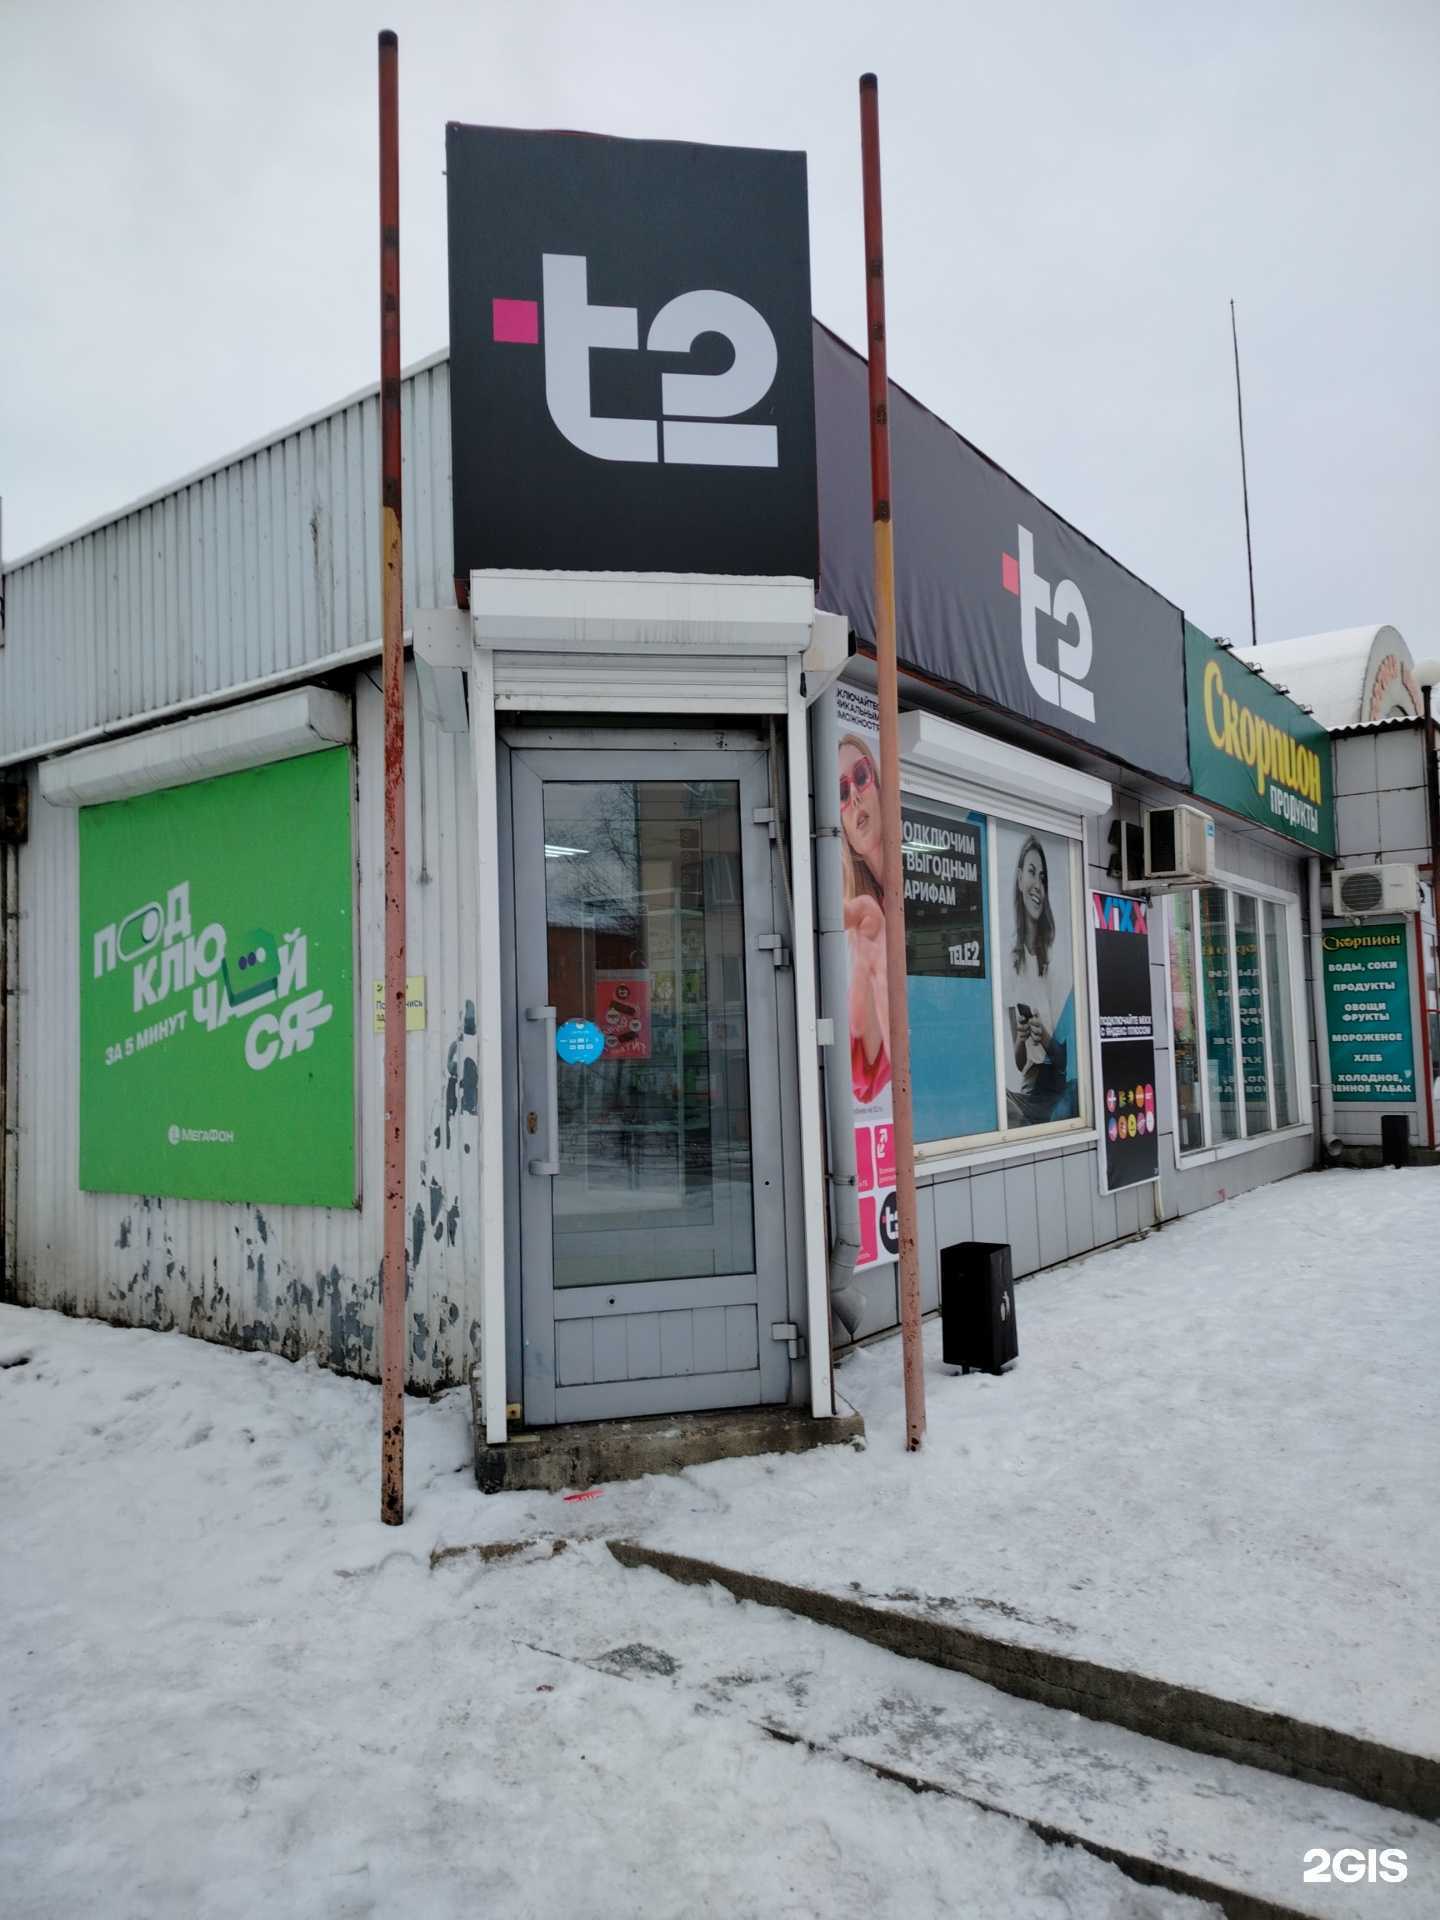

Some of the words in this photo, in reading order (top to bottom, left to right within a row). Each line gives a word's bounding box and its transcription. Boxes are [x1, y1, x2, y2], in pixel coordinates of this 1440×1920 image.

[542, 253, 779, 468] t2
[1017, 523, 1096, 724] t2
[1204, 660, 1321, 806] Скорпион
[901, 819, 976, 856] ОДКЛЮЧИМ
[905, 850, 978, 882] ВЫГОДНЫМ
[903, 878, 956, 906] АРИФАМ
[94, 880, 191, 979] ПОД
[949, 941, 981, 967] TELE2
[1323, 935, 1401, 951] Скорпион
[133, 922, 226, 1013] КЛЮ
[1367, 961, 1398, 971] СОКИ
[1333, 981, 1396, 993] ПРОДУКТЫ
[1342, 1012, 1390, 1023] ФРУКТЫ
[1344, 1003, 1387, 1012] ОВОЩИ
[104, 1043, 123, 1067] ЗА
[125, 1037, 135, 1057] 5
[136, 1010, 188, 1051] МИНУТ
[1331, 1033, 1403, 1043] МОРОЖЕНОЕ
[1354, 1053, 1383, 1063] ХЛЕБ
[1338, 1074, 1403, 1084] ХОЛОДНОЕ,
[1375, 1083, 1412, 1093] ТАБАК
